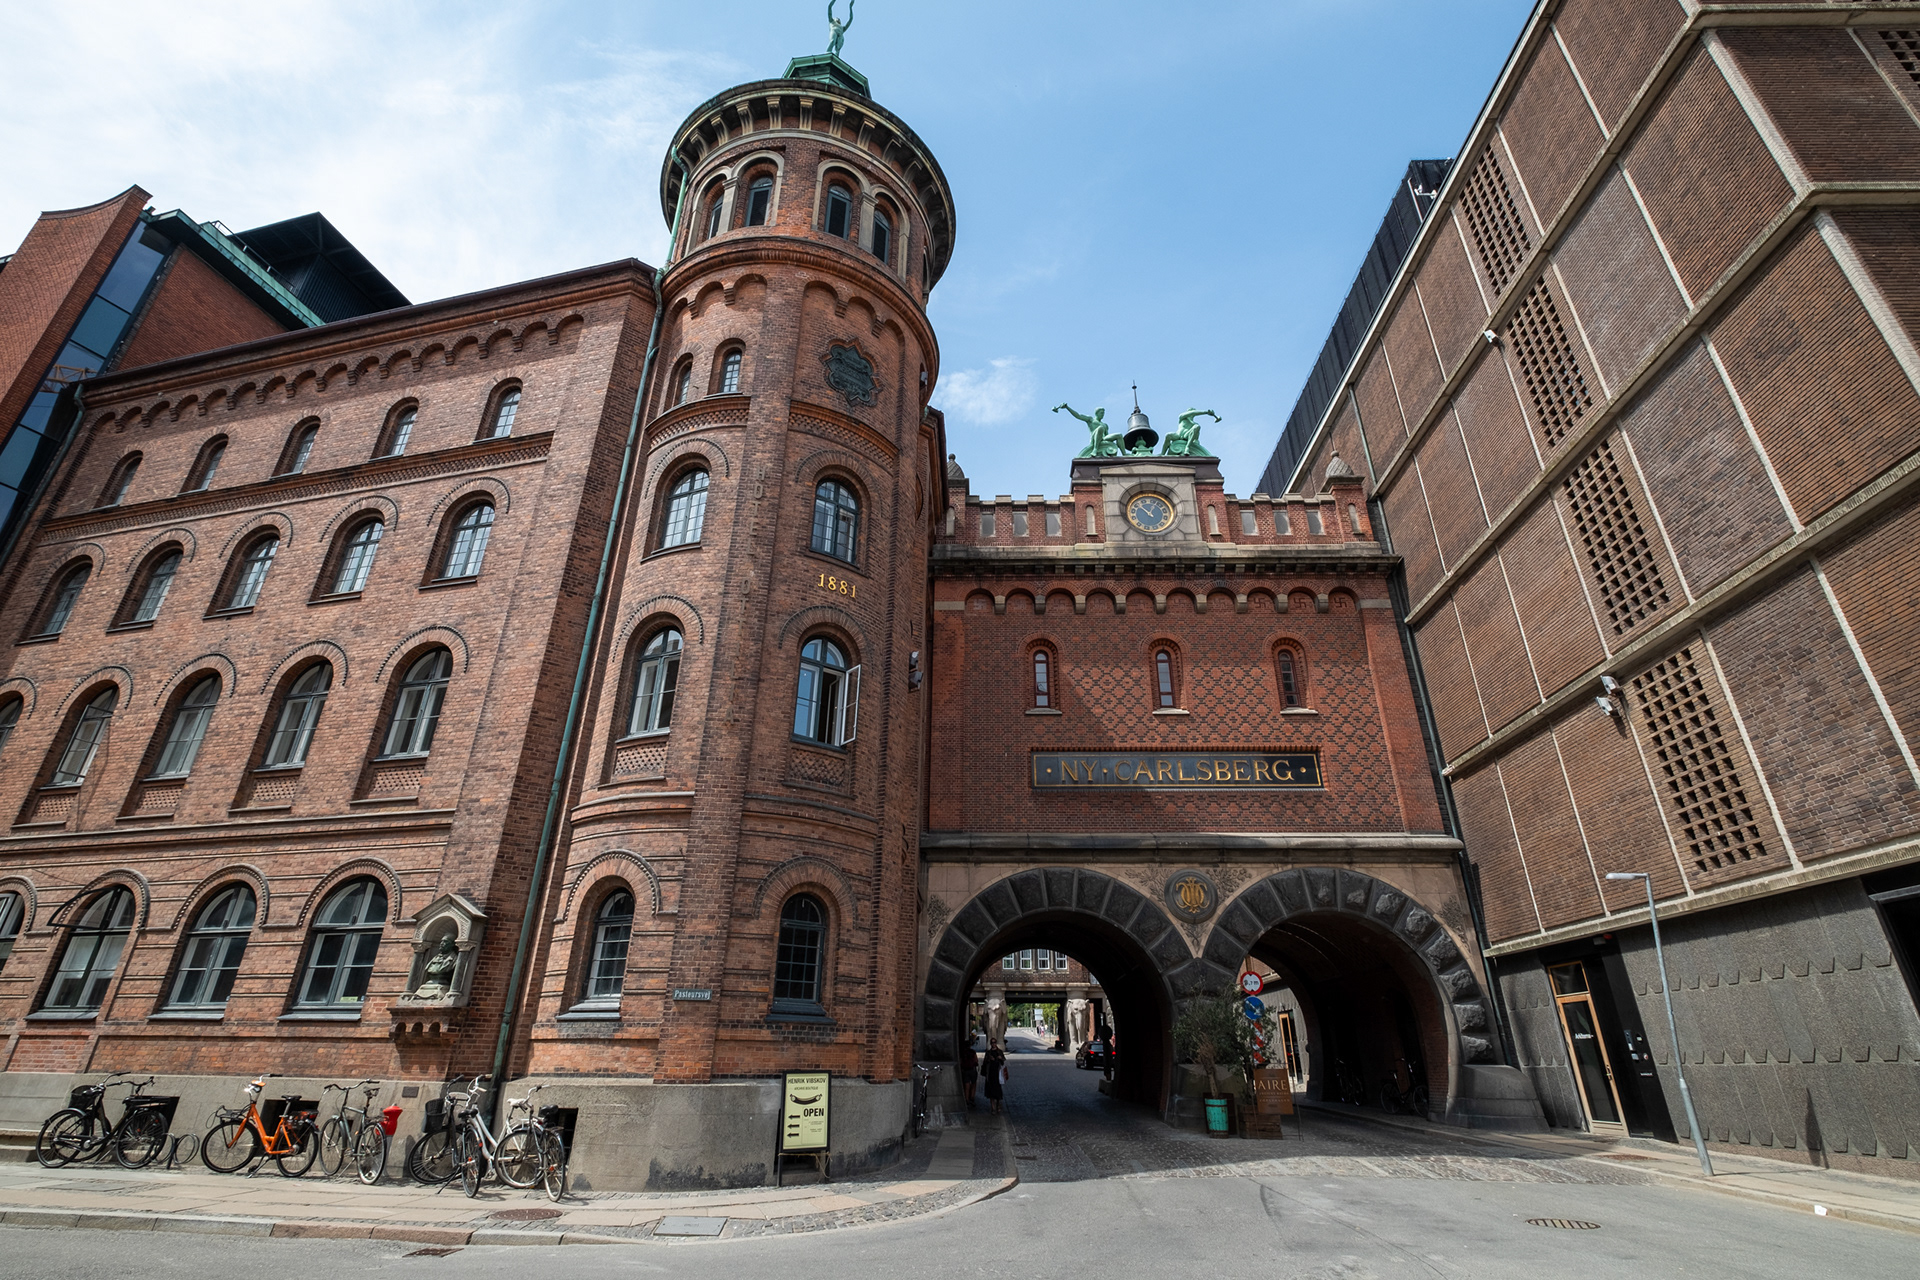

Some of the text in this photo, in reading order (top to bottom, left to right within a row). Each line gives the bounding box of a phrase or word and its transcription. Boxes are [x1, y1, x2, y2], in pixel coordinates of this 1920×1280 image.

[817, 573, 856, 598] 1881
[1061, 760, 1295, 782] NY CARLSBERG
[1258, 1080, 1288, 1091] AIRE
[803, 1108, 825, 1117] OPEN
